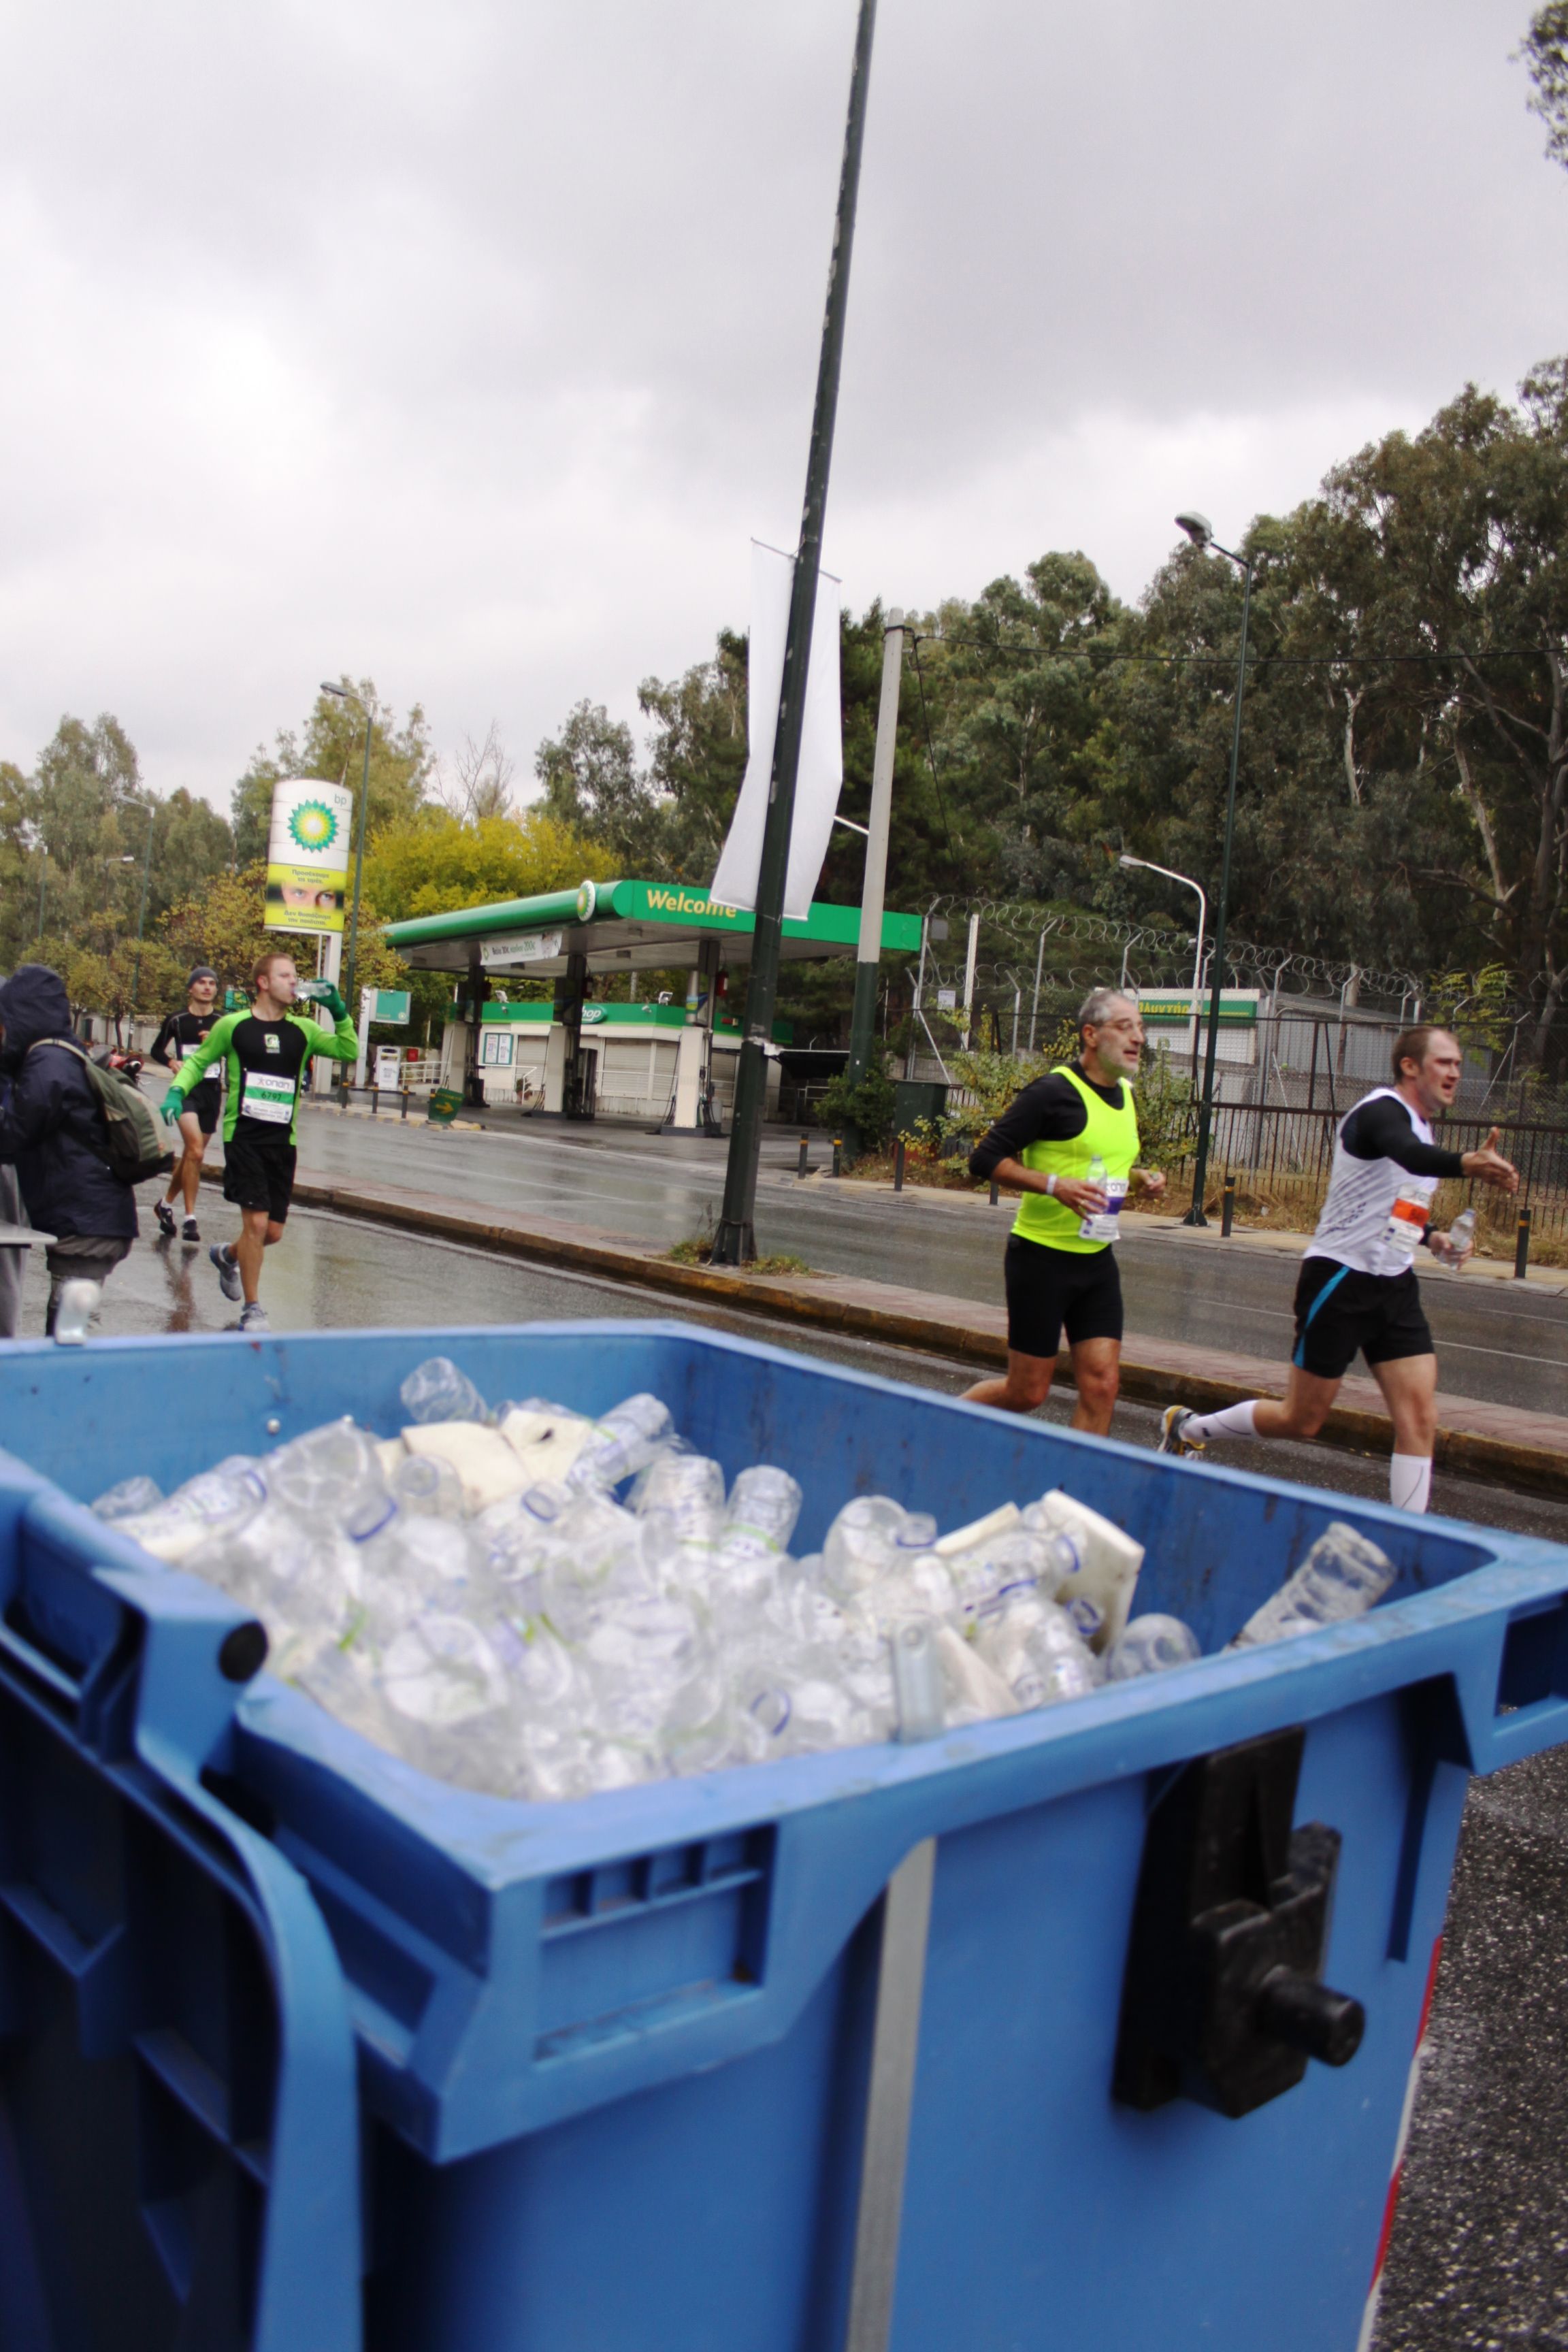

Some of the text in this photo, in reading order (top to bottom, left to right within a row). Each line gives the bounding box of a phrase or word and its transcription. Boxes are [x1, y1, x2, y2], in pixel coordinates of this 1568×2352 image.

[334, 794, 347, 807] bp
[647, 889, 736, 917] Welcome
[582, 1005, 602, 1022] hop
[261, 1091, 282, 1101] 6797
